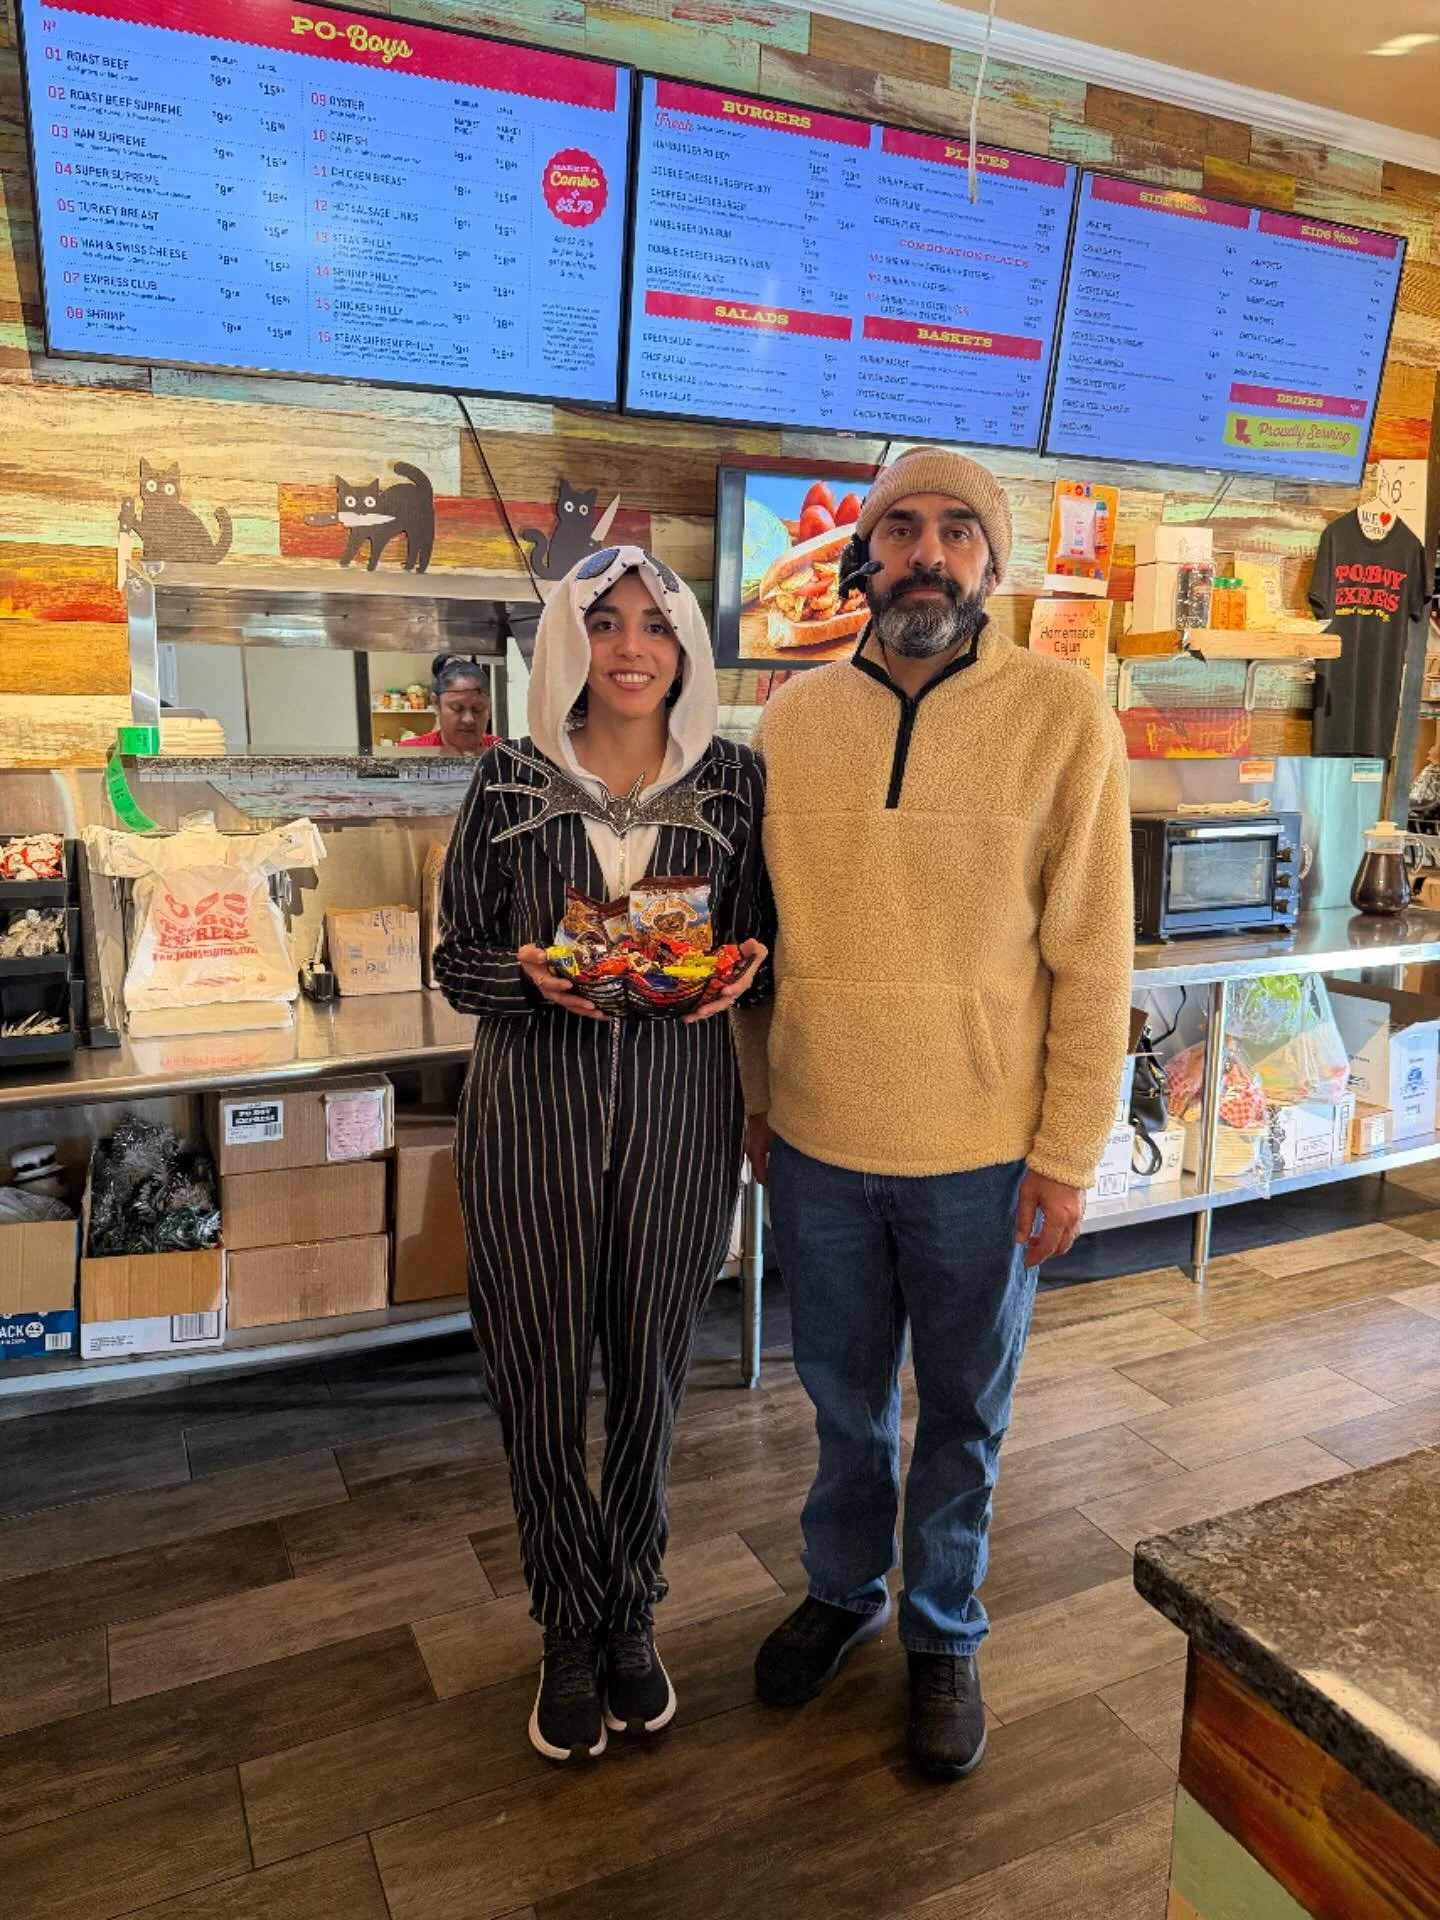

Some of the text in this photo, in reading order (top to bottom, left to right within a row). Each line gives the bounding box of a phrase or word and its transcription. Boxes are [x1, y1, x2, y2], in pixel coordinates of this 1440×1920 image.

[290, 16, 413, 63] PO-Boys
[45, 46, 129, 70] 01 ROAST BEEF
[48, 85, 66, 100] 02
[70, 89, 102, 104] ROAST
[105, 95, 133, 108] BEEF
[134, 99, 184, 117] SUPREME
[311, 92, 365, 111] 09 OYSTER
[655, 112, 694, 133] Fresh
[721, 100, 812, 129] BURGERS
[51, 124, 147, 148] 03 HAM SUPREME
[313, 128, 368, 146] 10 CATFISH
[55, 161, 160, 186] 04 SUPER SUPREME
[313, 164, 327, 177] 11
[331, 166, 371, 181] CHICKEN
[550, 170, 600, 188] Combo
[57, 198, 160, 221] 05 TURKEY BREAST
[314, 199, 328, 212] 12
[315, 230, 328, 243] 13
[60, 235, 78, 249] 06
[81, 237, 104, 249] HAM
[105, 240, 114, 250] &
[116, 242, 147, 255] SWISS
[149, 246, 188, 260] CHEESE
[315, 264, 330, 277] 14
[63, 271, 158, 290] 07 EXPRESS CLUB
[66, 306, 126, 321] 08 SHRIMP
[316, 298, 331, 311] 15
[334, 299, 373, 312] CHICKEN
[715, 305, 789, 325] SALADS
[917, 328, 993, 348] BASKETS
[1277, 394, 1323, 408] DRINKS
[1258, 422, 1351, 447] Proudly Serving
[1040, 626, 1096, 639] Homemade
[1054, 640, 1081, 656] Cajun
